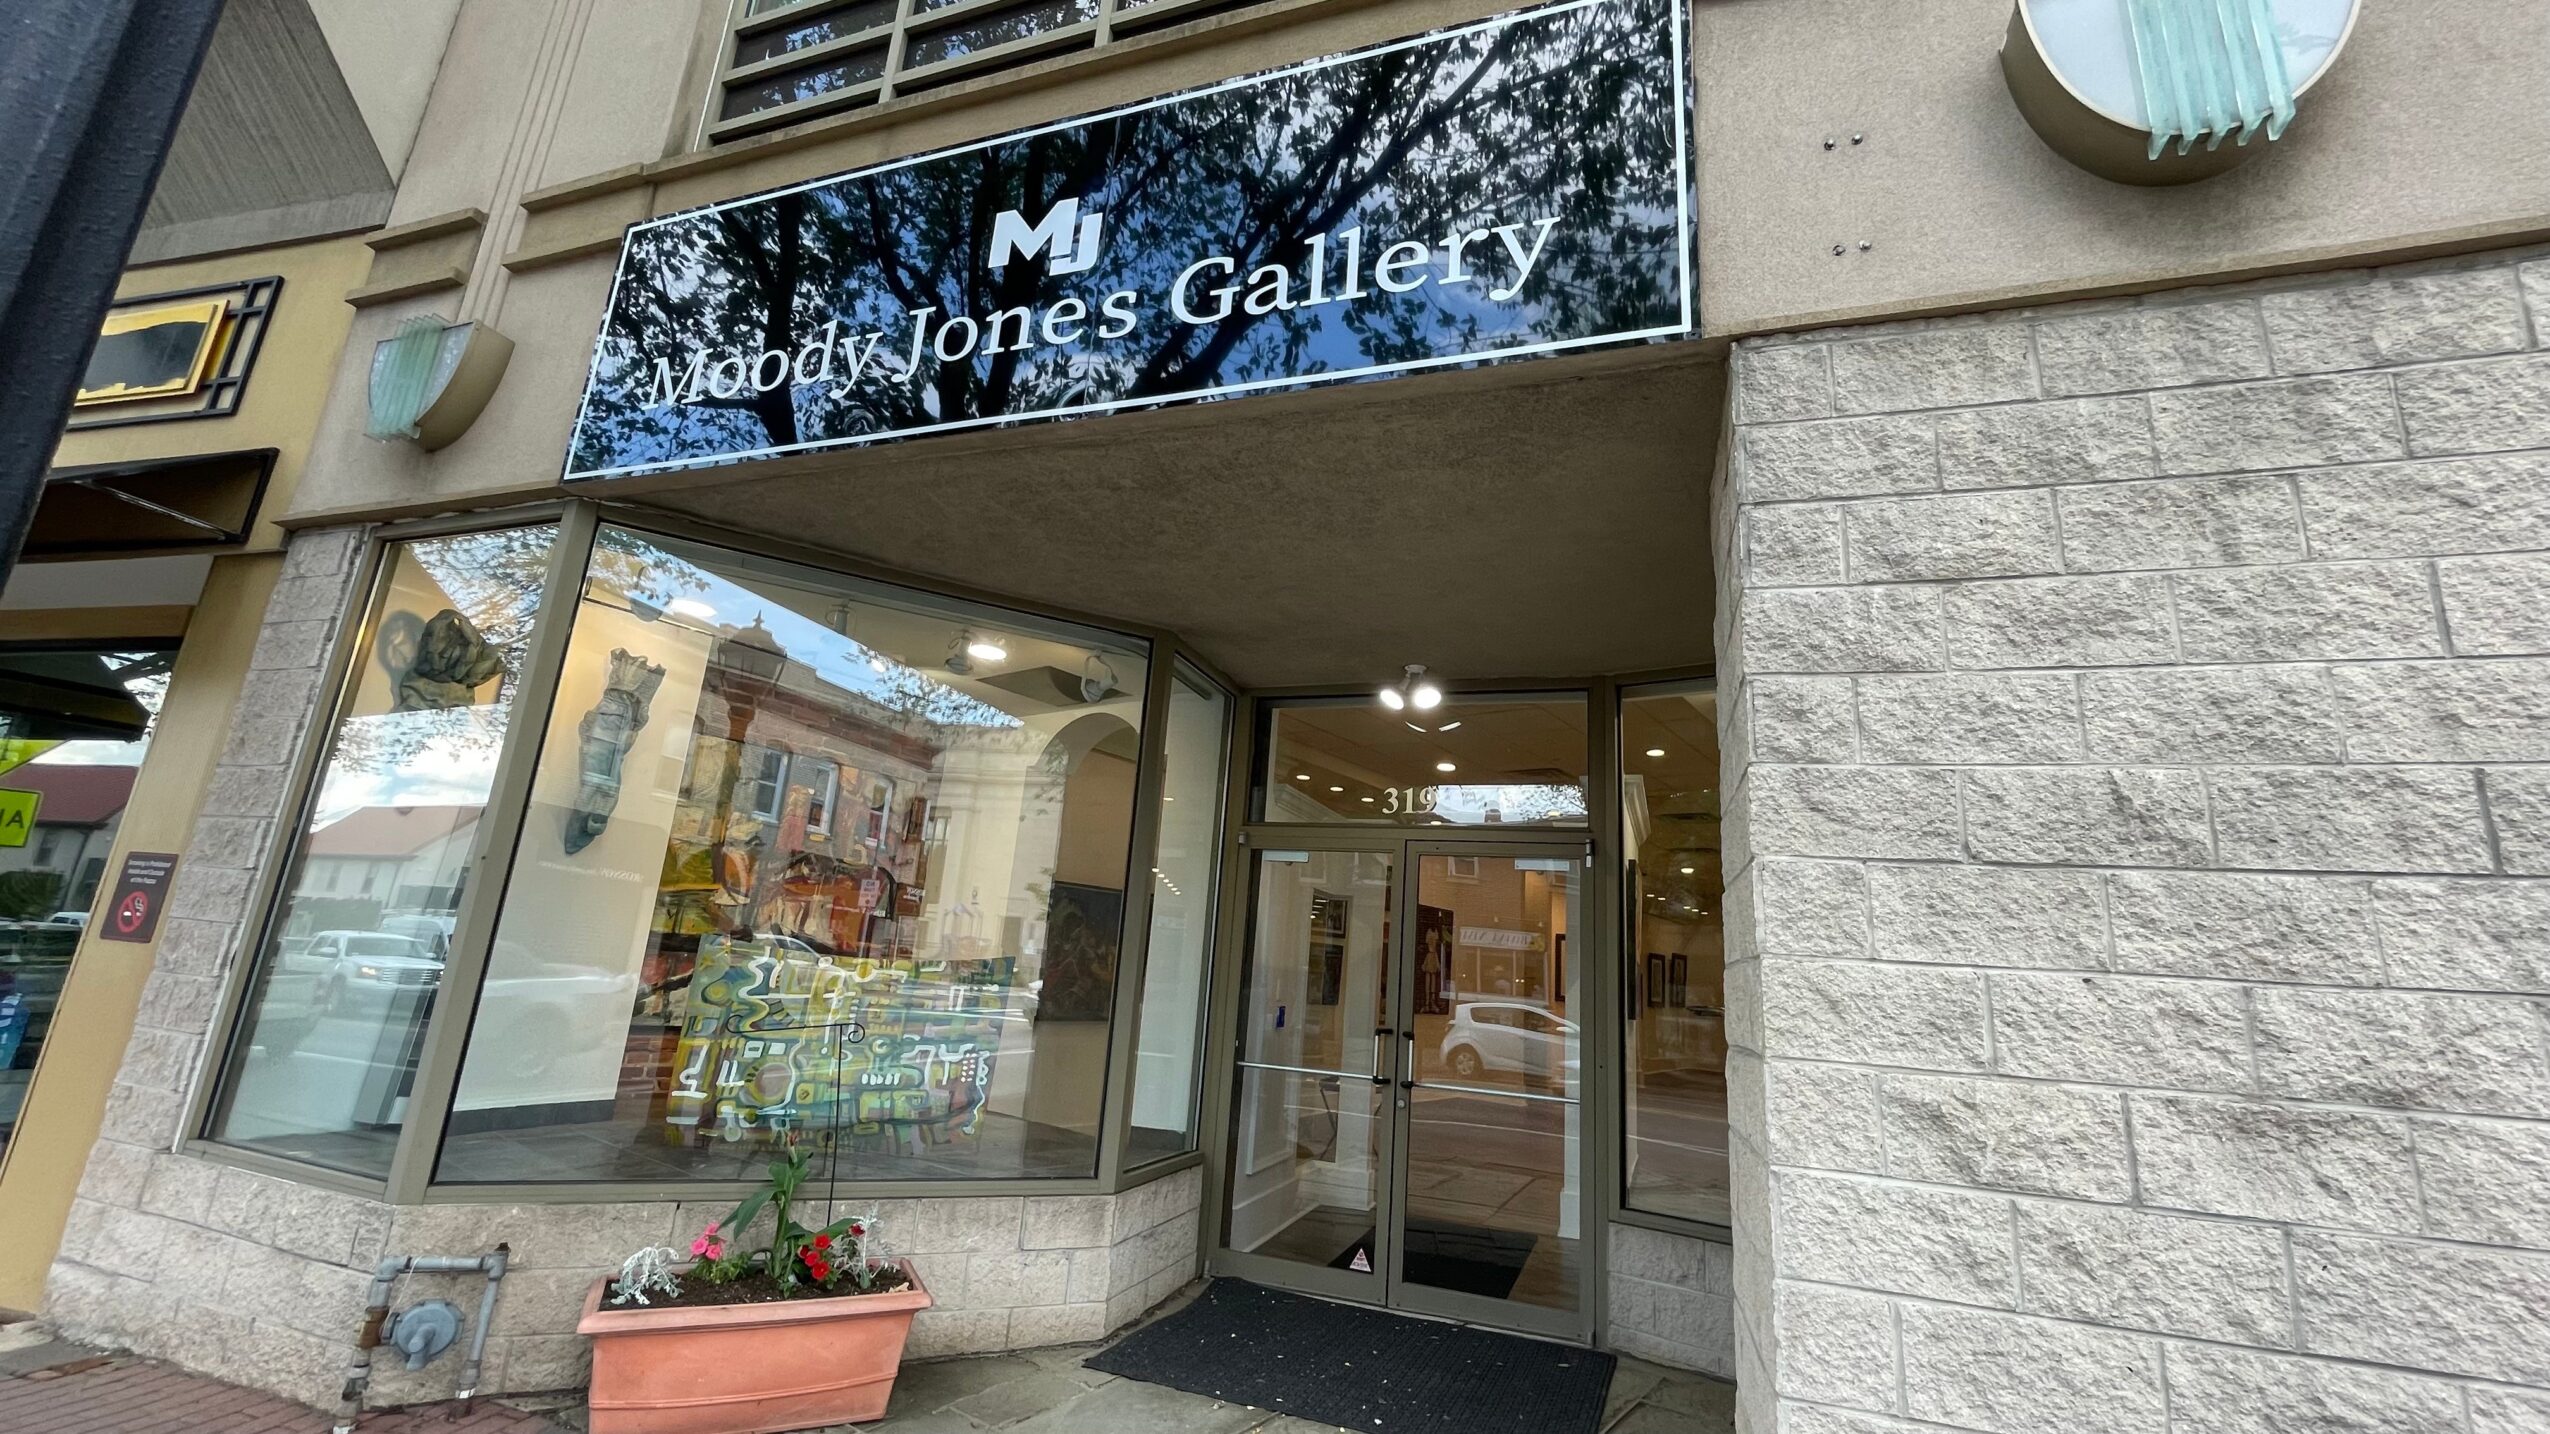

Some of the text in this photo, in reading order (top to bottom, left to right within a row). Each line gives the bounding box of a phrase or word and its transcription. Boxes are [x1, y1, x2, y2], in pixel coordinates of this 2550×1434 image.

[988, 197, 1103, 276] MJ
[641, 216, 1561, 410] Moody Jones Gallery
[1382, 786, 1437, 814] 319
